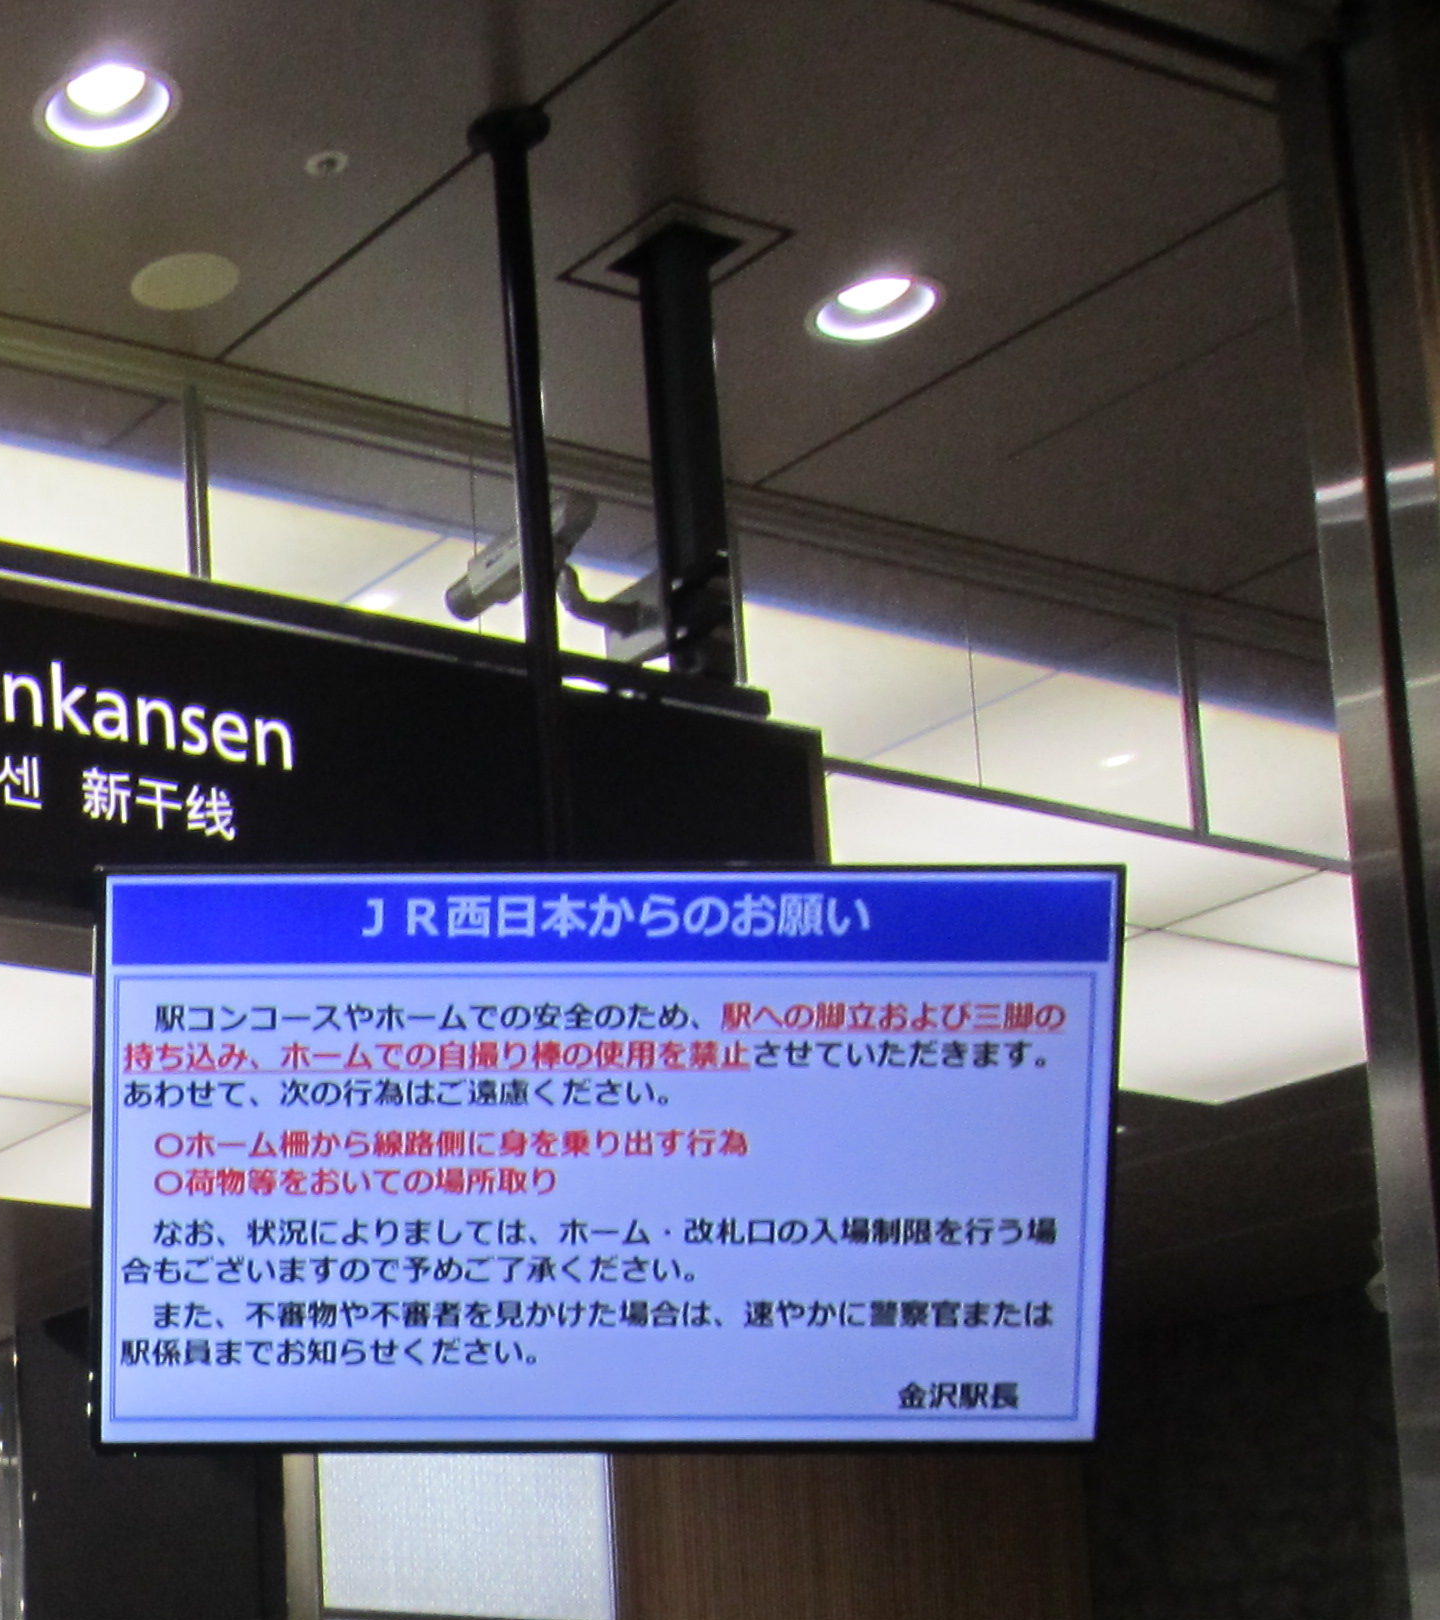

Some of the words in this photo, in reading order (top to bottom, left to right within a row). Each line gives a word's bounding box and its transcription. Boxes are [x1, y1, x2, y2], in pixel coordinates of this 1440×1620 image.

[83, 767, 237, 842] 新干线
[362, 893, 871, 938] JR西日本からのお願い
[123, 1079, 670, 1108] あわせて、次の行為はご遠慮ください。
[121, 1255, 698, 1285] 合もございますので予めご了承ください。
[121, 1338, 540, 1367] 駅係員までお知らせください。
[897, 1382, 1021, 1410] 金沢駅長
